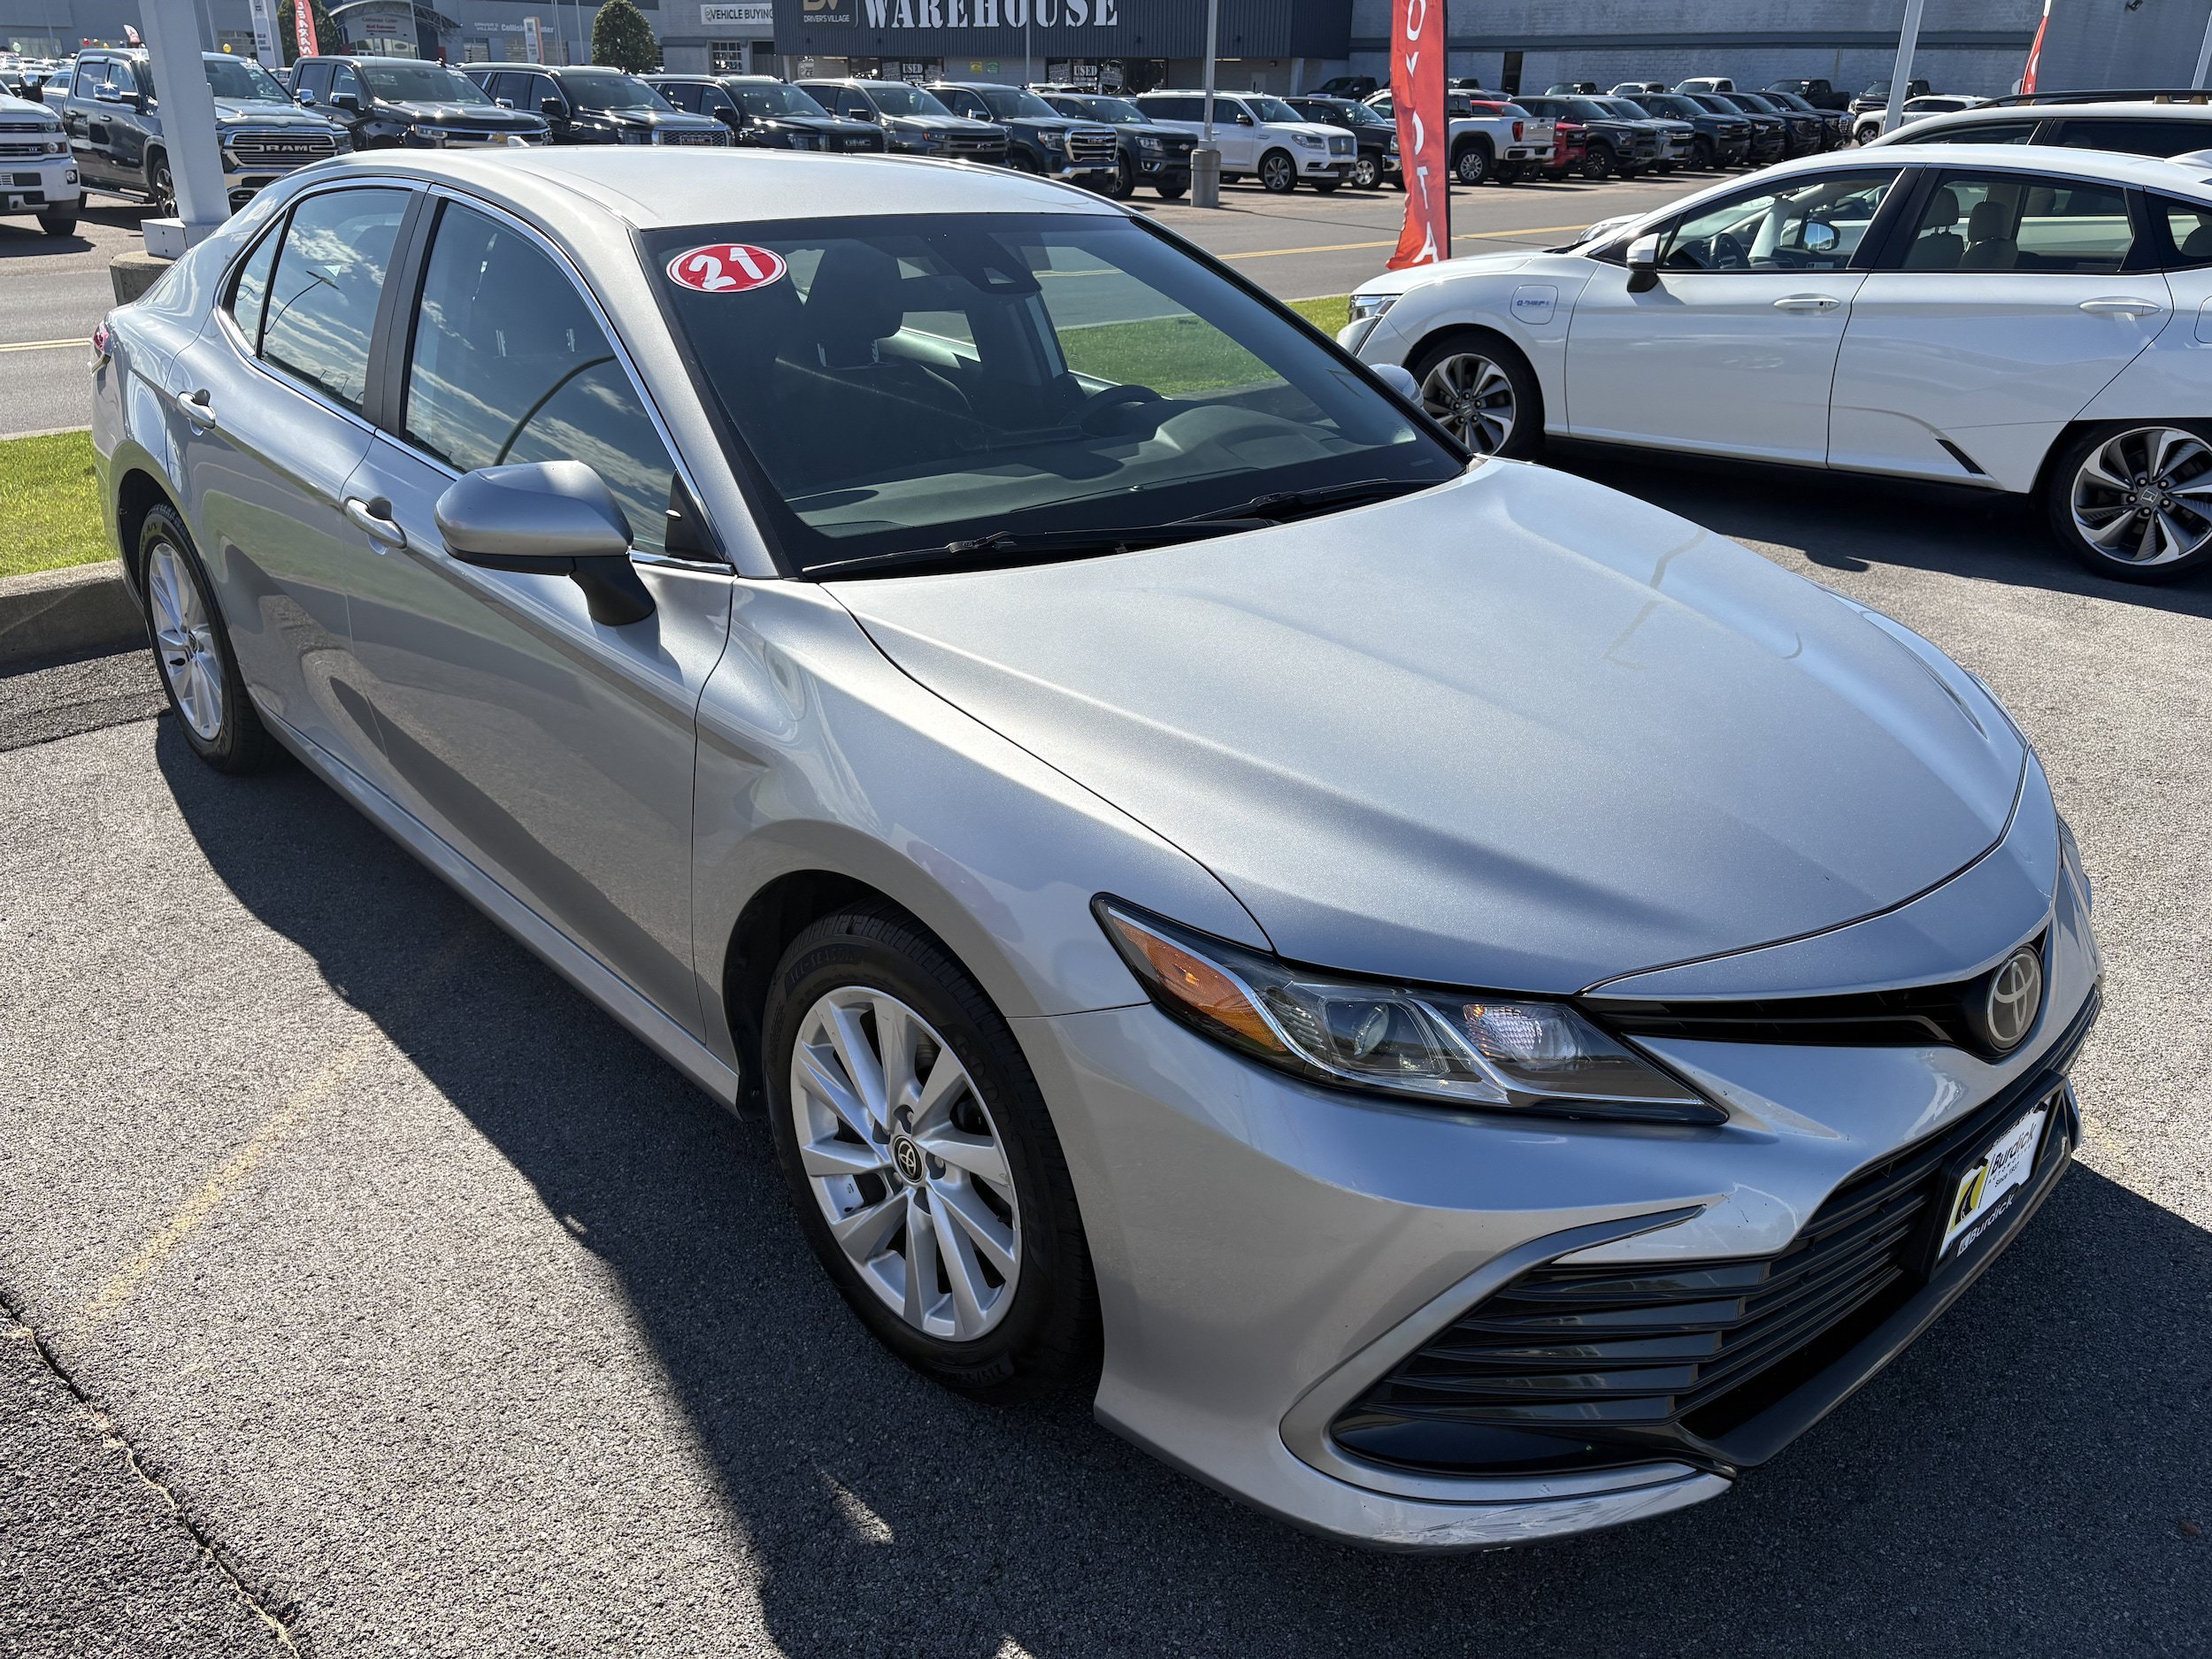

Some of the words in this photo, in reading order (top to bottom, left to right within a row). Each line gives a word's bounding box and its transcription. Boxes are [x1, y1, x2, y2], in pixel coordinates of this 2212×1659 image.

[710, 9, 743, 19] VEHICLE
[827, 14, 850, 23] VILLAGE
[864, 0, 1118, 28] WAREHOUSE
[902, 63, 924, 74] USED
[1073, 65, 1098, 77] USED
[687, 246, 764, 290] 21
[1991, 1122, 2037, 1176] Burdick
[1969, 1194, 2016, 1245] Burdick
